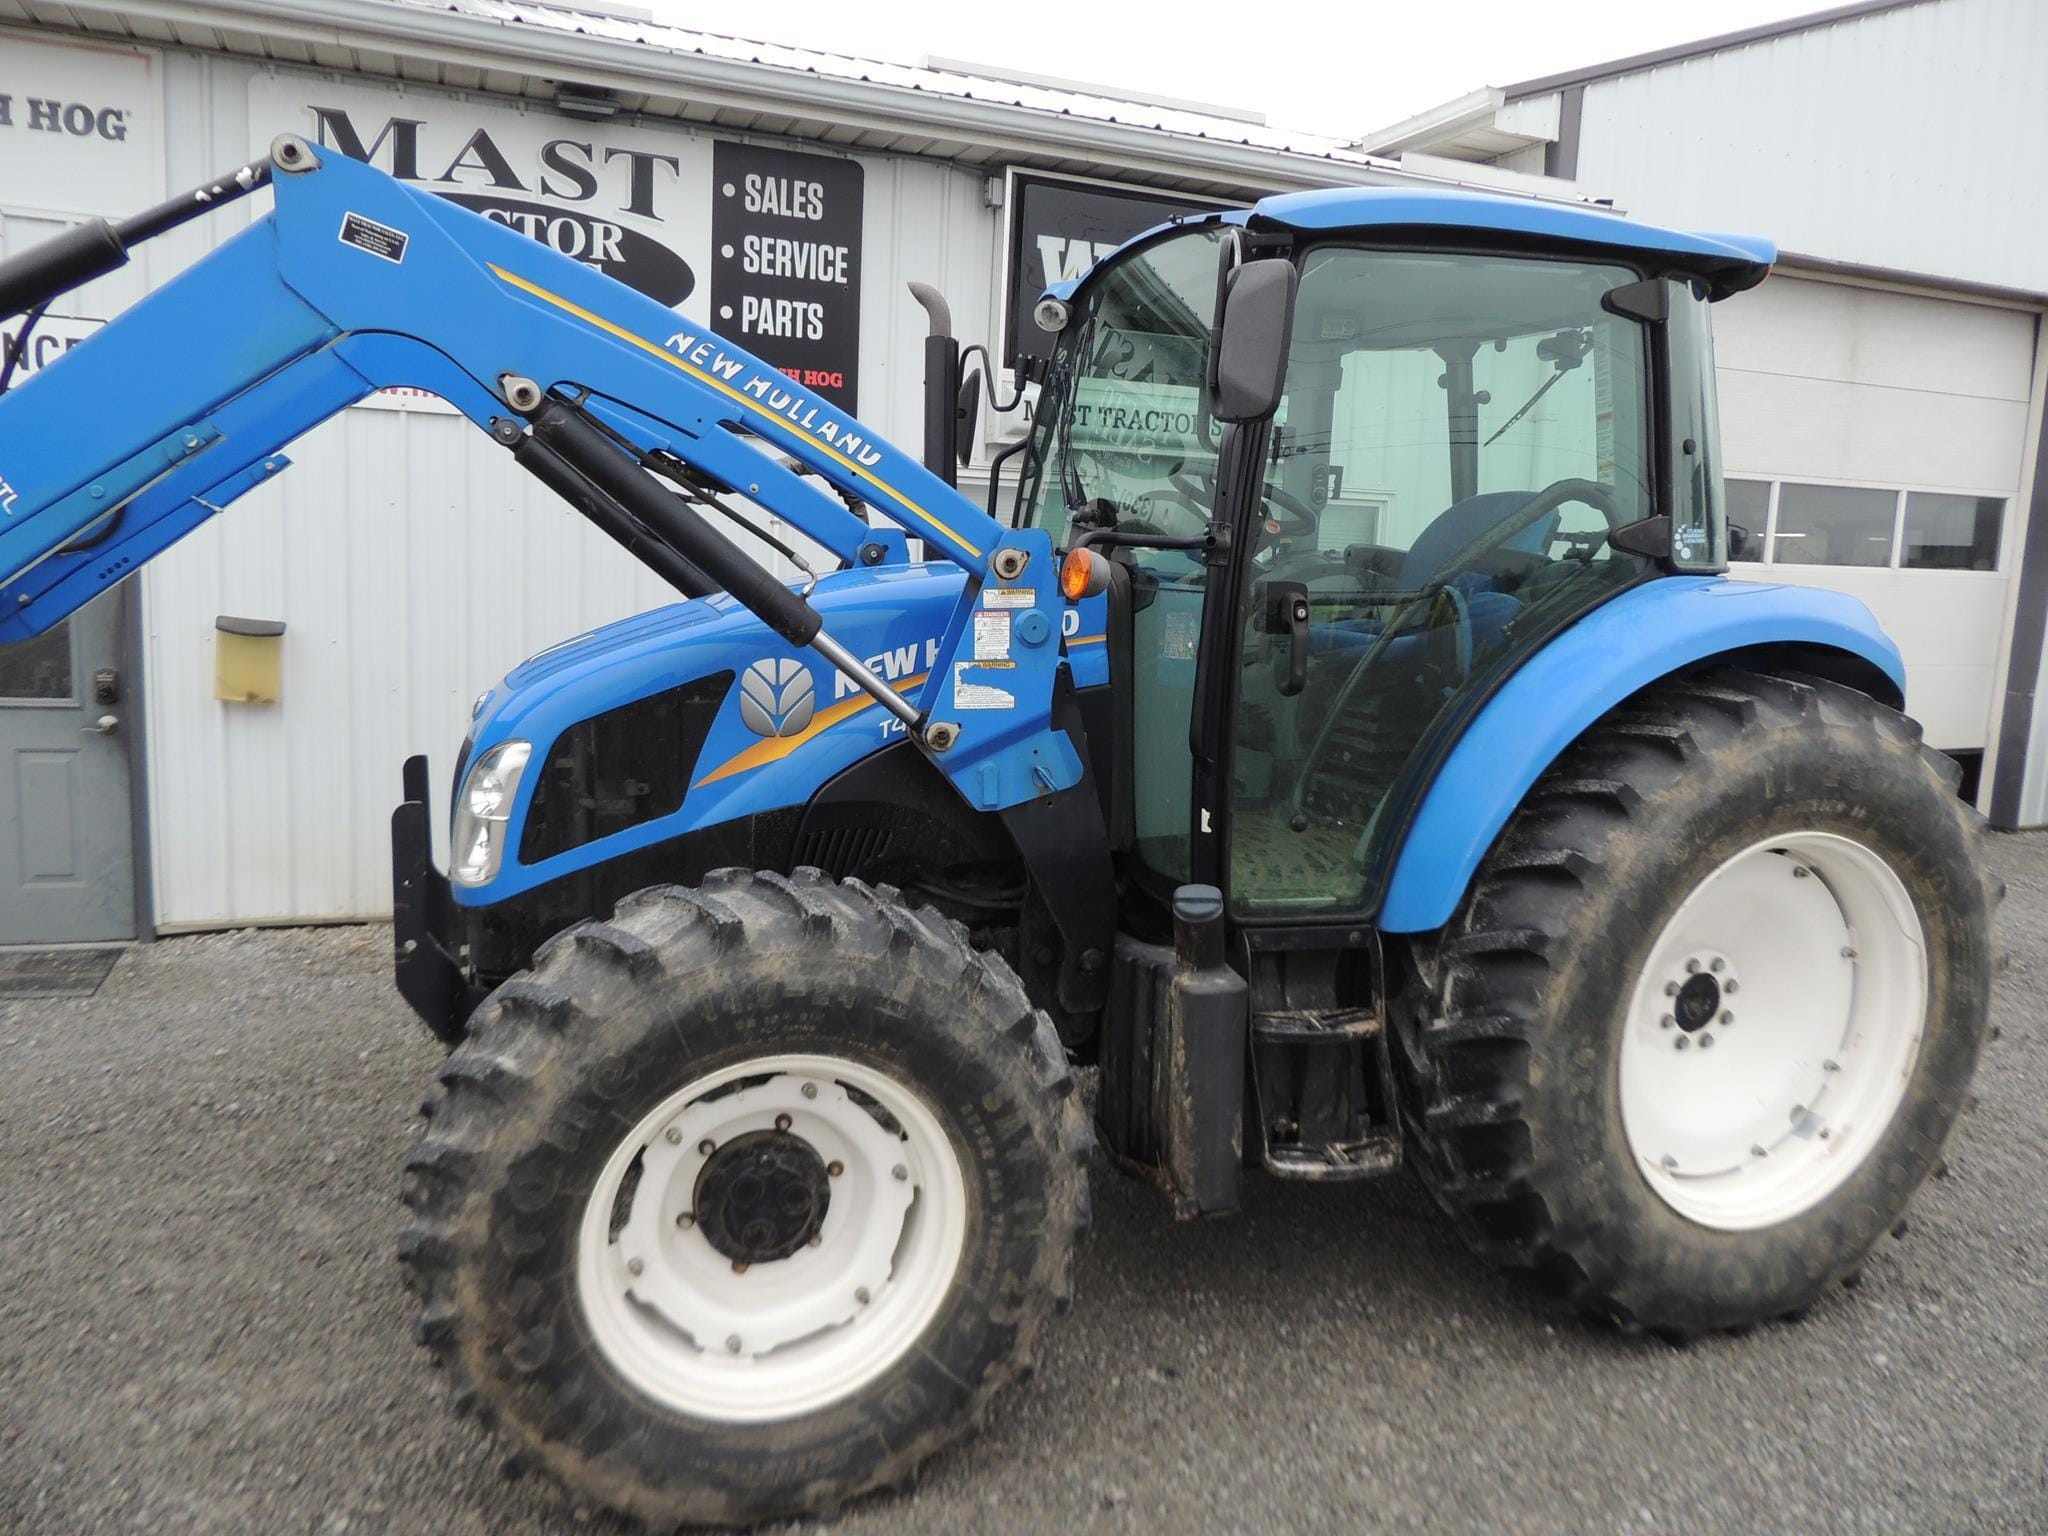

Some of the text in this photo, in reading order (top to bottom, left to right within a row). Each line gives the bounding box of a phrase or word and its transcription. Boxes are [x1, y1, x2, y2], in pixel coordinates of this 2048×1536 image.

[26, 96, 127, 141] HOG
[307, 105, 680, 222] MAST
[744, 173, 824, 221] SALES
[743, 234, 849, 284] SERVICE
[742, 296, 824, 340] PARTS
[664, 331, 745, 381] NEW
[804, 370, 844, 389] HOG
[835, 643, 918, 699] NEW
[982, 661, 1011, 669] WARNING
